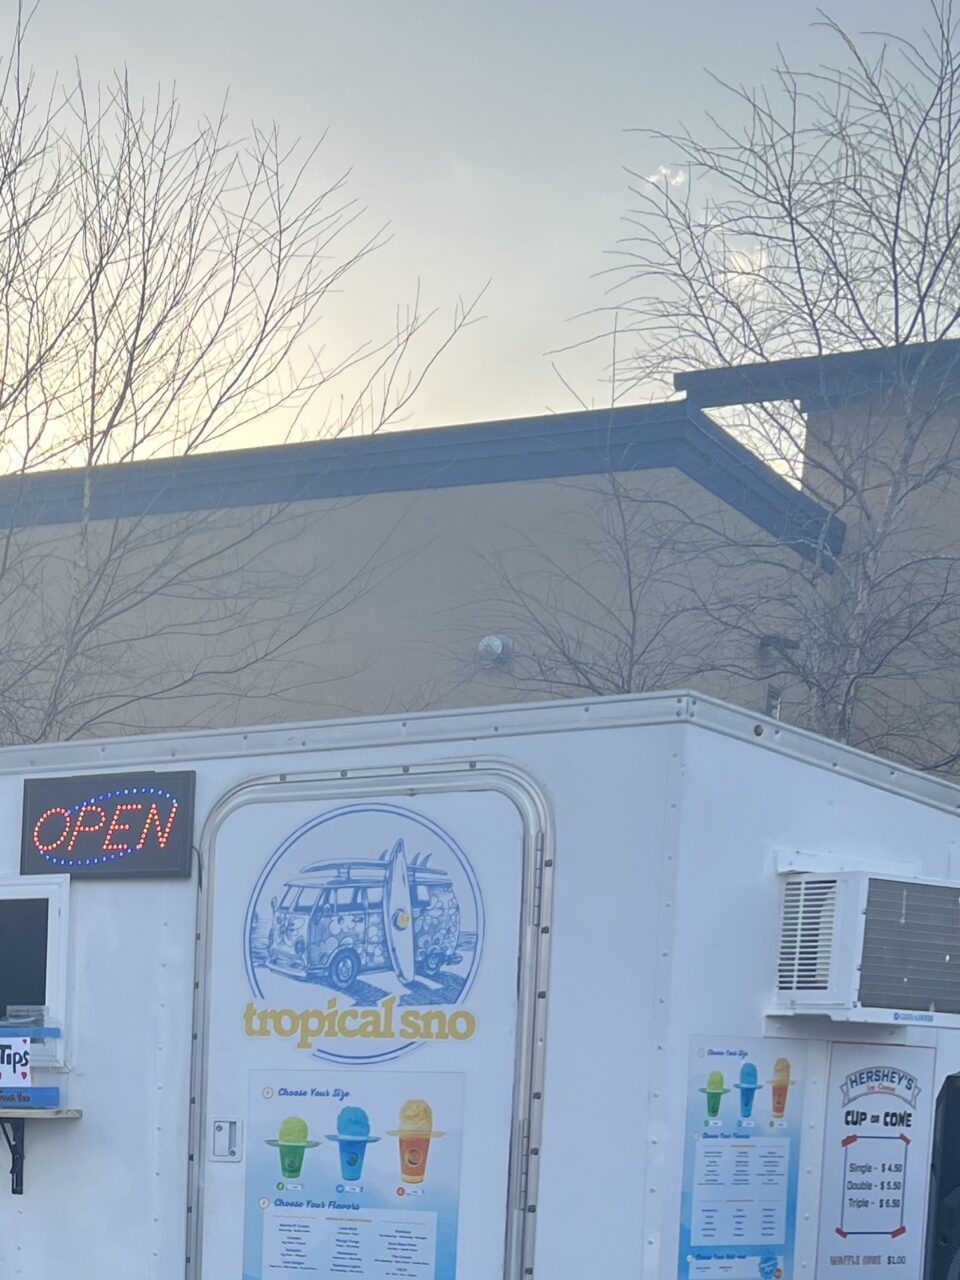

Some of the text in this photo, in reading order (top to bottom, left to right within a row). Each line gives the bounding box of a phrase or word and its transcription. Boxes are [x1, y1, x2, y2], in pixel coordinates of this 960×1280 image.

[32, 802, 179, 852] OPEN
[243, 997, 476, 1049] tropical sno
[849, 1069, 915, 1092] HERSHEY'S
[278, 1087, 307, 1097] Choose
[844, 1110, 867, 1126] CUP
[883, 1110, 912, 1127] CONE
[849, 1163, 872, 1174] Single
[847, 1181, 872, 1190] Double
[274, 1199, 303, 1208] Choose
[848, 1198, 869, 1209] Triple
[887, 1255, 907, 1265] $1.00
